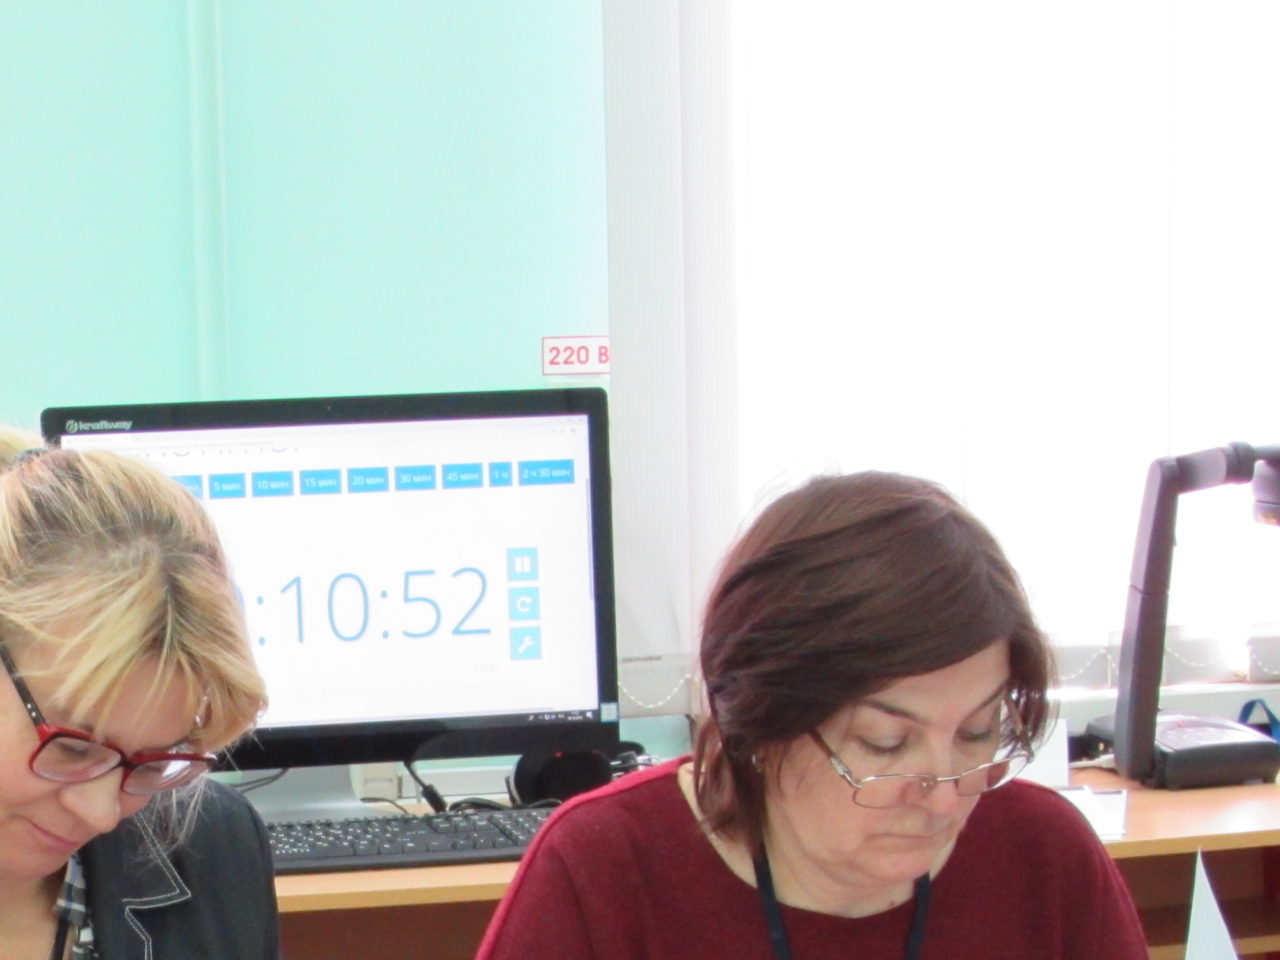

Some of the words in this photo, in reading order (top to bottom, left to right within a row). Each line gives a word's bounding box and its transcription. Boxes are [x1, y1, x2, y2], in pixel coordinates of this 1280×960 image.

[548, 345, 590, 366] 220
[78, 420, 133, 431] kraftway
[446, 472, 459, 481] 45
[460, 473, 480, 481] мин
[551, 469, 571, 477] мин
[304, 478, 317, 487] 15
[352, 476, 365, 485] 20
[365, 477, 385, 485] мин
[399, 474, 412, 483] 30
[412, 475, 433, 483] мин
[213, 482, 220, 491] 5
[256, 481, 269, 489] 10
[235, 567, 491, 645] :10:52
